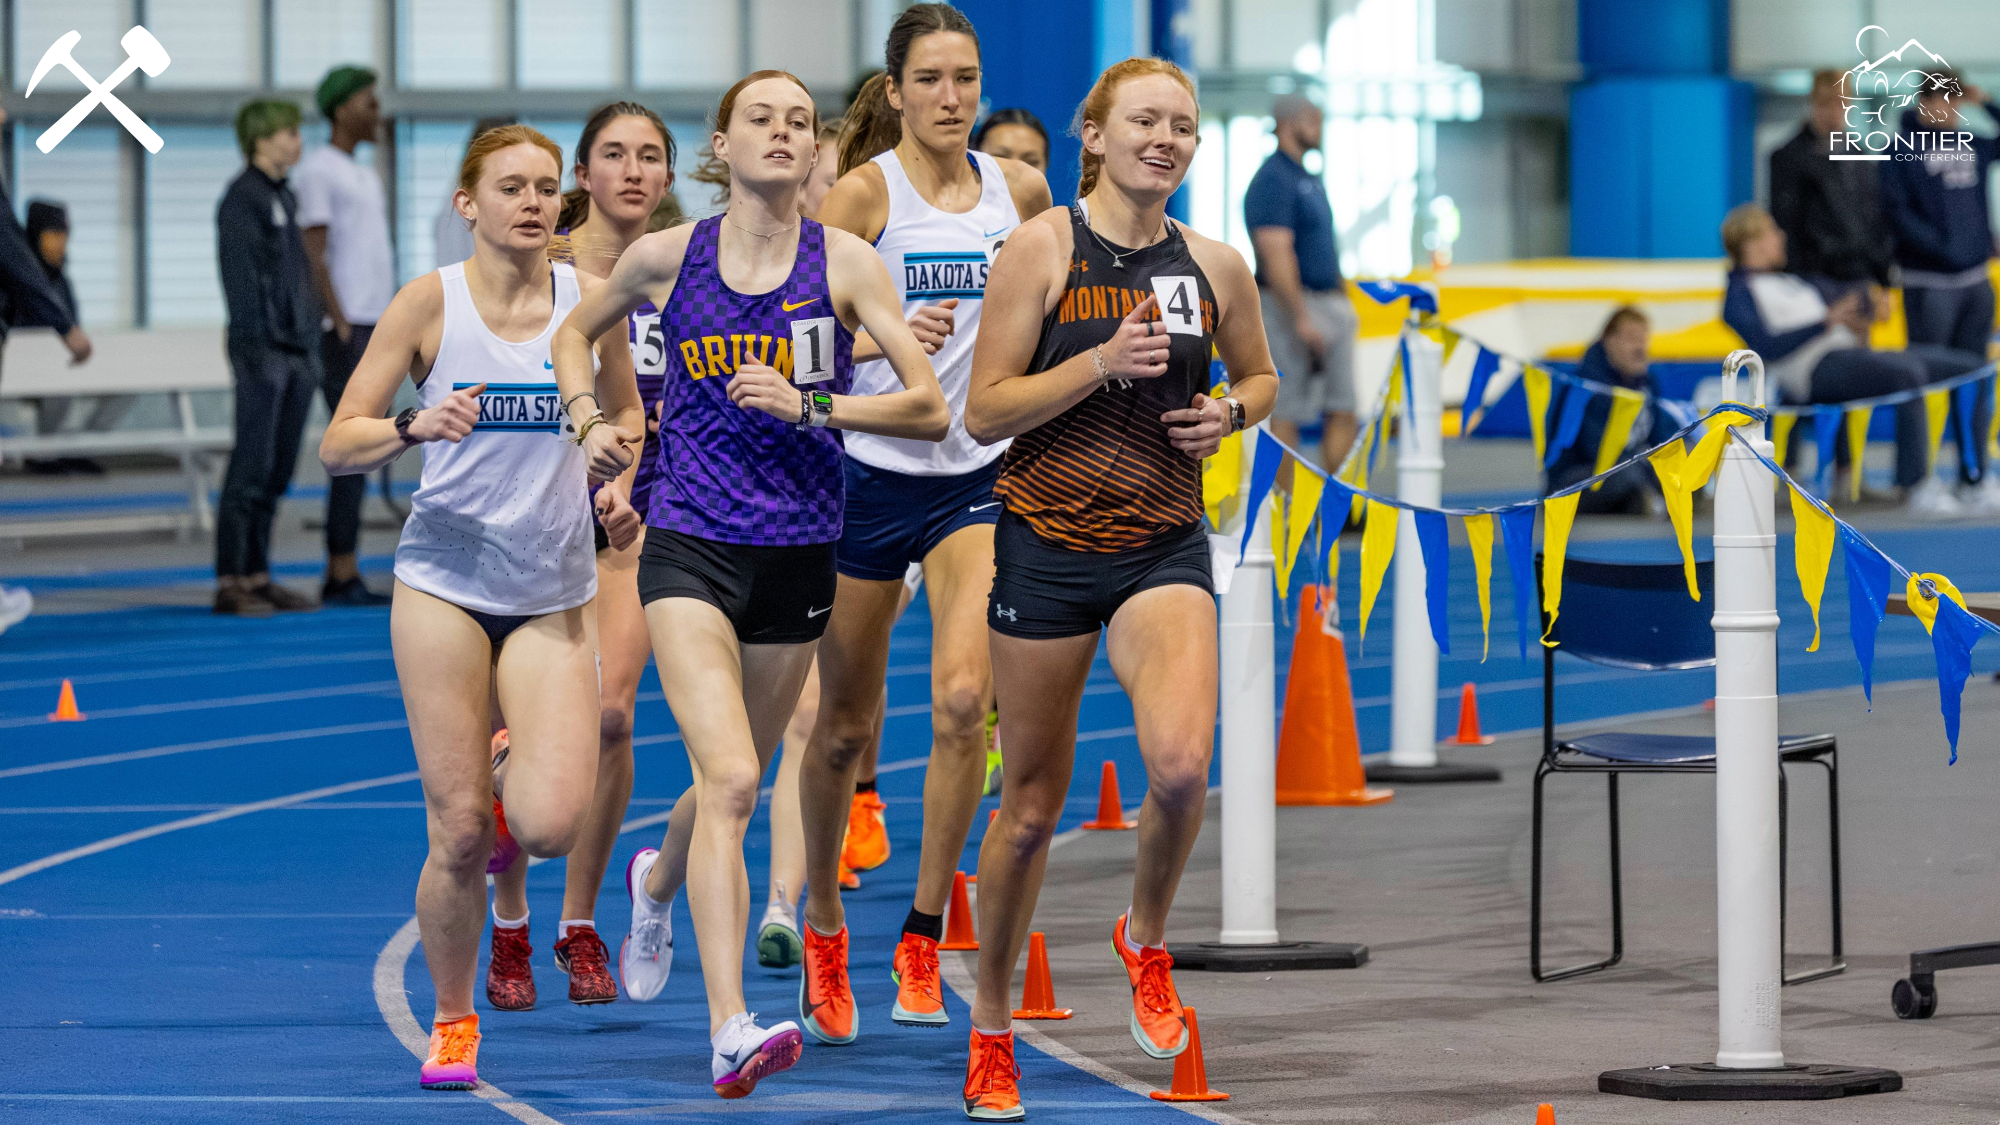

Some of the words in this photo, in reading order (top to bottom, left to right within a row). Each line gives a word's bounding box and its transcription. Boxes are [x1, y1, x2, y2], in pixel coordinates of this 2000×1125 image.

[904, 263, 974, 291] DAKOTA
[1167, 281, 1194, 325] 4
[643, 323, 664, 367] 5
[679, 334, 796, 381] BRUIN
[802, 324, 826, 375] 1
[478, 395, 529, 422] KOTA
